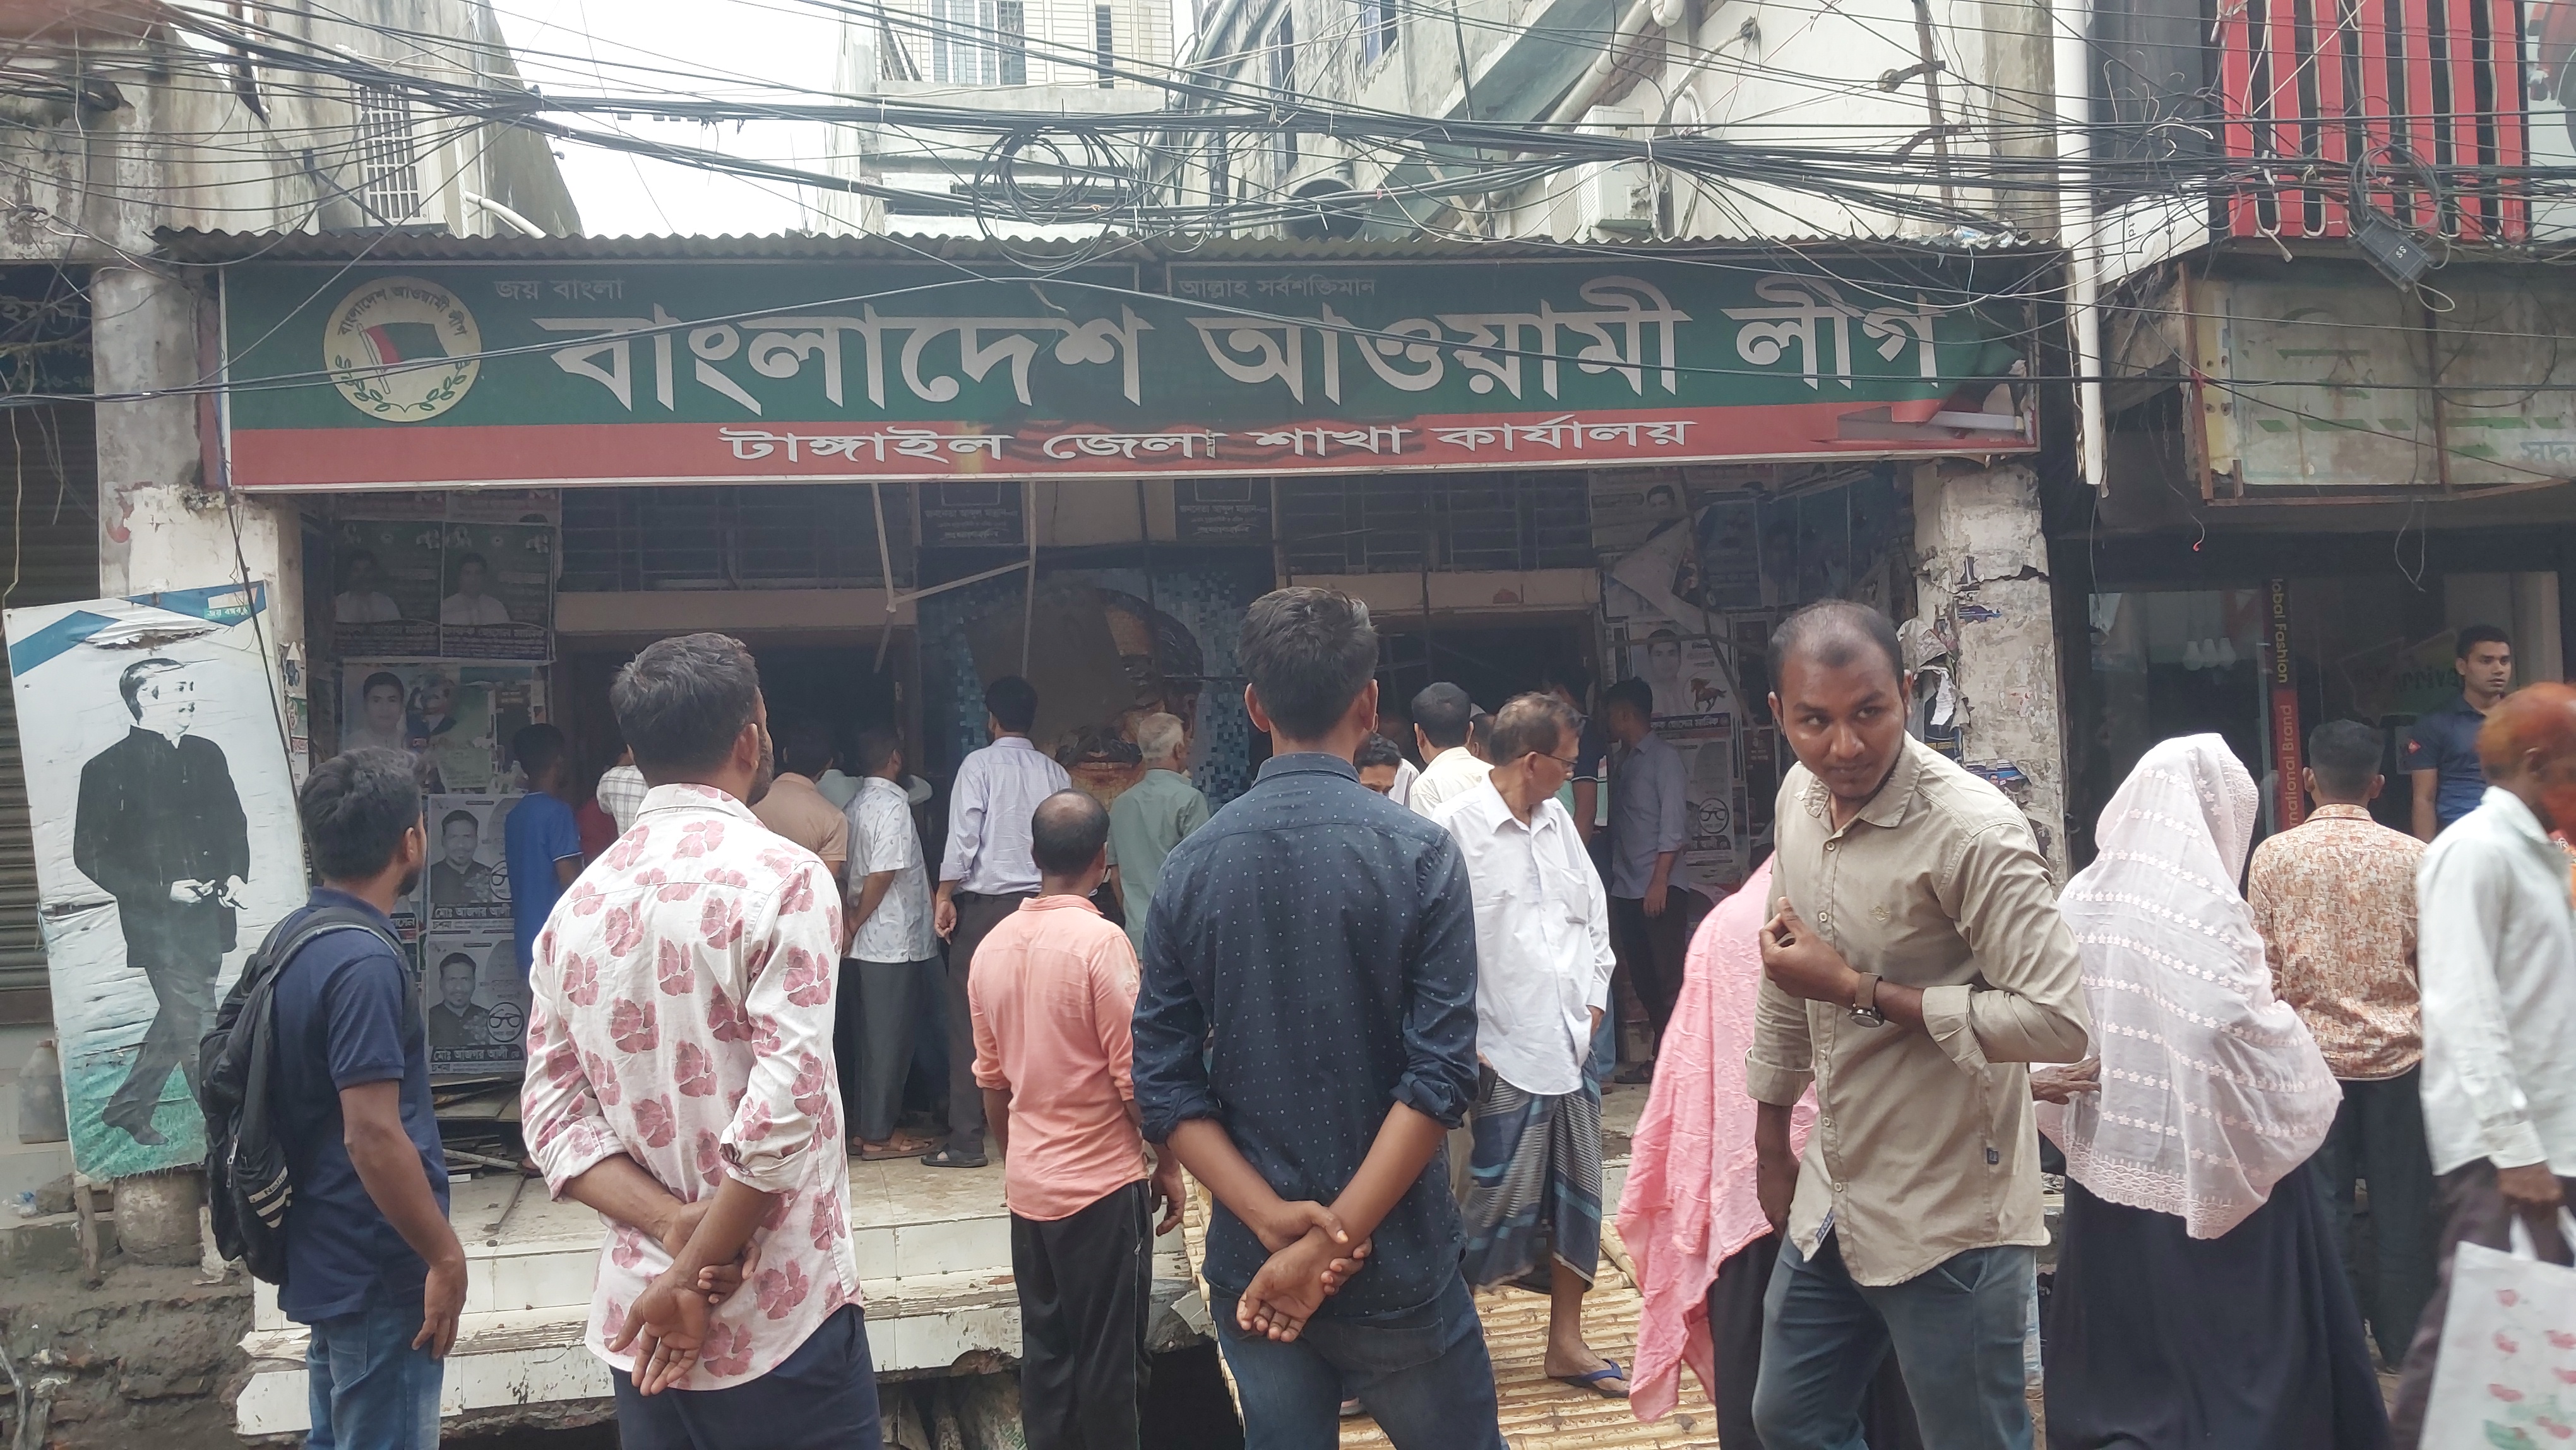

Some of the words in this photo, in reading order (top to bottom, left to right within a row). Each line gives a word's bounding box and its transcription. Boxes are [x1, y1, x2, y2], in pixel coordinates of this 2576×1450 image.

[337, 289, 387, 335] বাংলাদেশ
[390, 285, 450, 313] আওয়ামী
[448, 309, 468, 335] লীগ
[493, 280, 542, 300] জয়
[549, 278, 625, 301] বাংলা
[1177, 279, 1251, 299] আল্লাহ
[1256, 273, 1376, 297] সর্বশক্তিমান
[532, 303, 1156, 416] বাংলাদেশ
[1185, 275, 1693, 406] আওয়ামী
[1720, 275, 1948, 390] লীগ
[719, 425, 1012, 464] টাঙ্গাইল
[1042, 428, 1229, 460] জেলা
[1244, 426, 1414, 457] শাখা
[1428, 414, 1698, 452] কার্যালয়
[2272, 578, 2286, 619] lobal
[2275, 623, 2289, 683] Fashion
[2279, 705, 2294, 752] Brand
[2283, 756, 2299, 827] rnational
